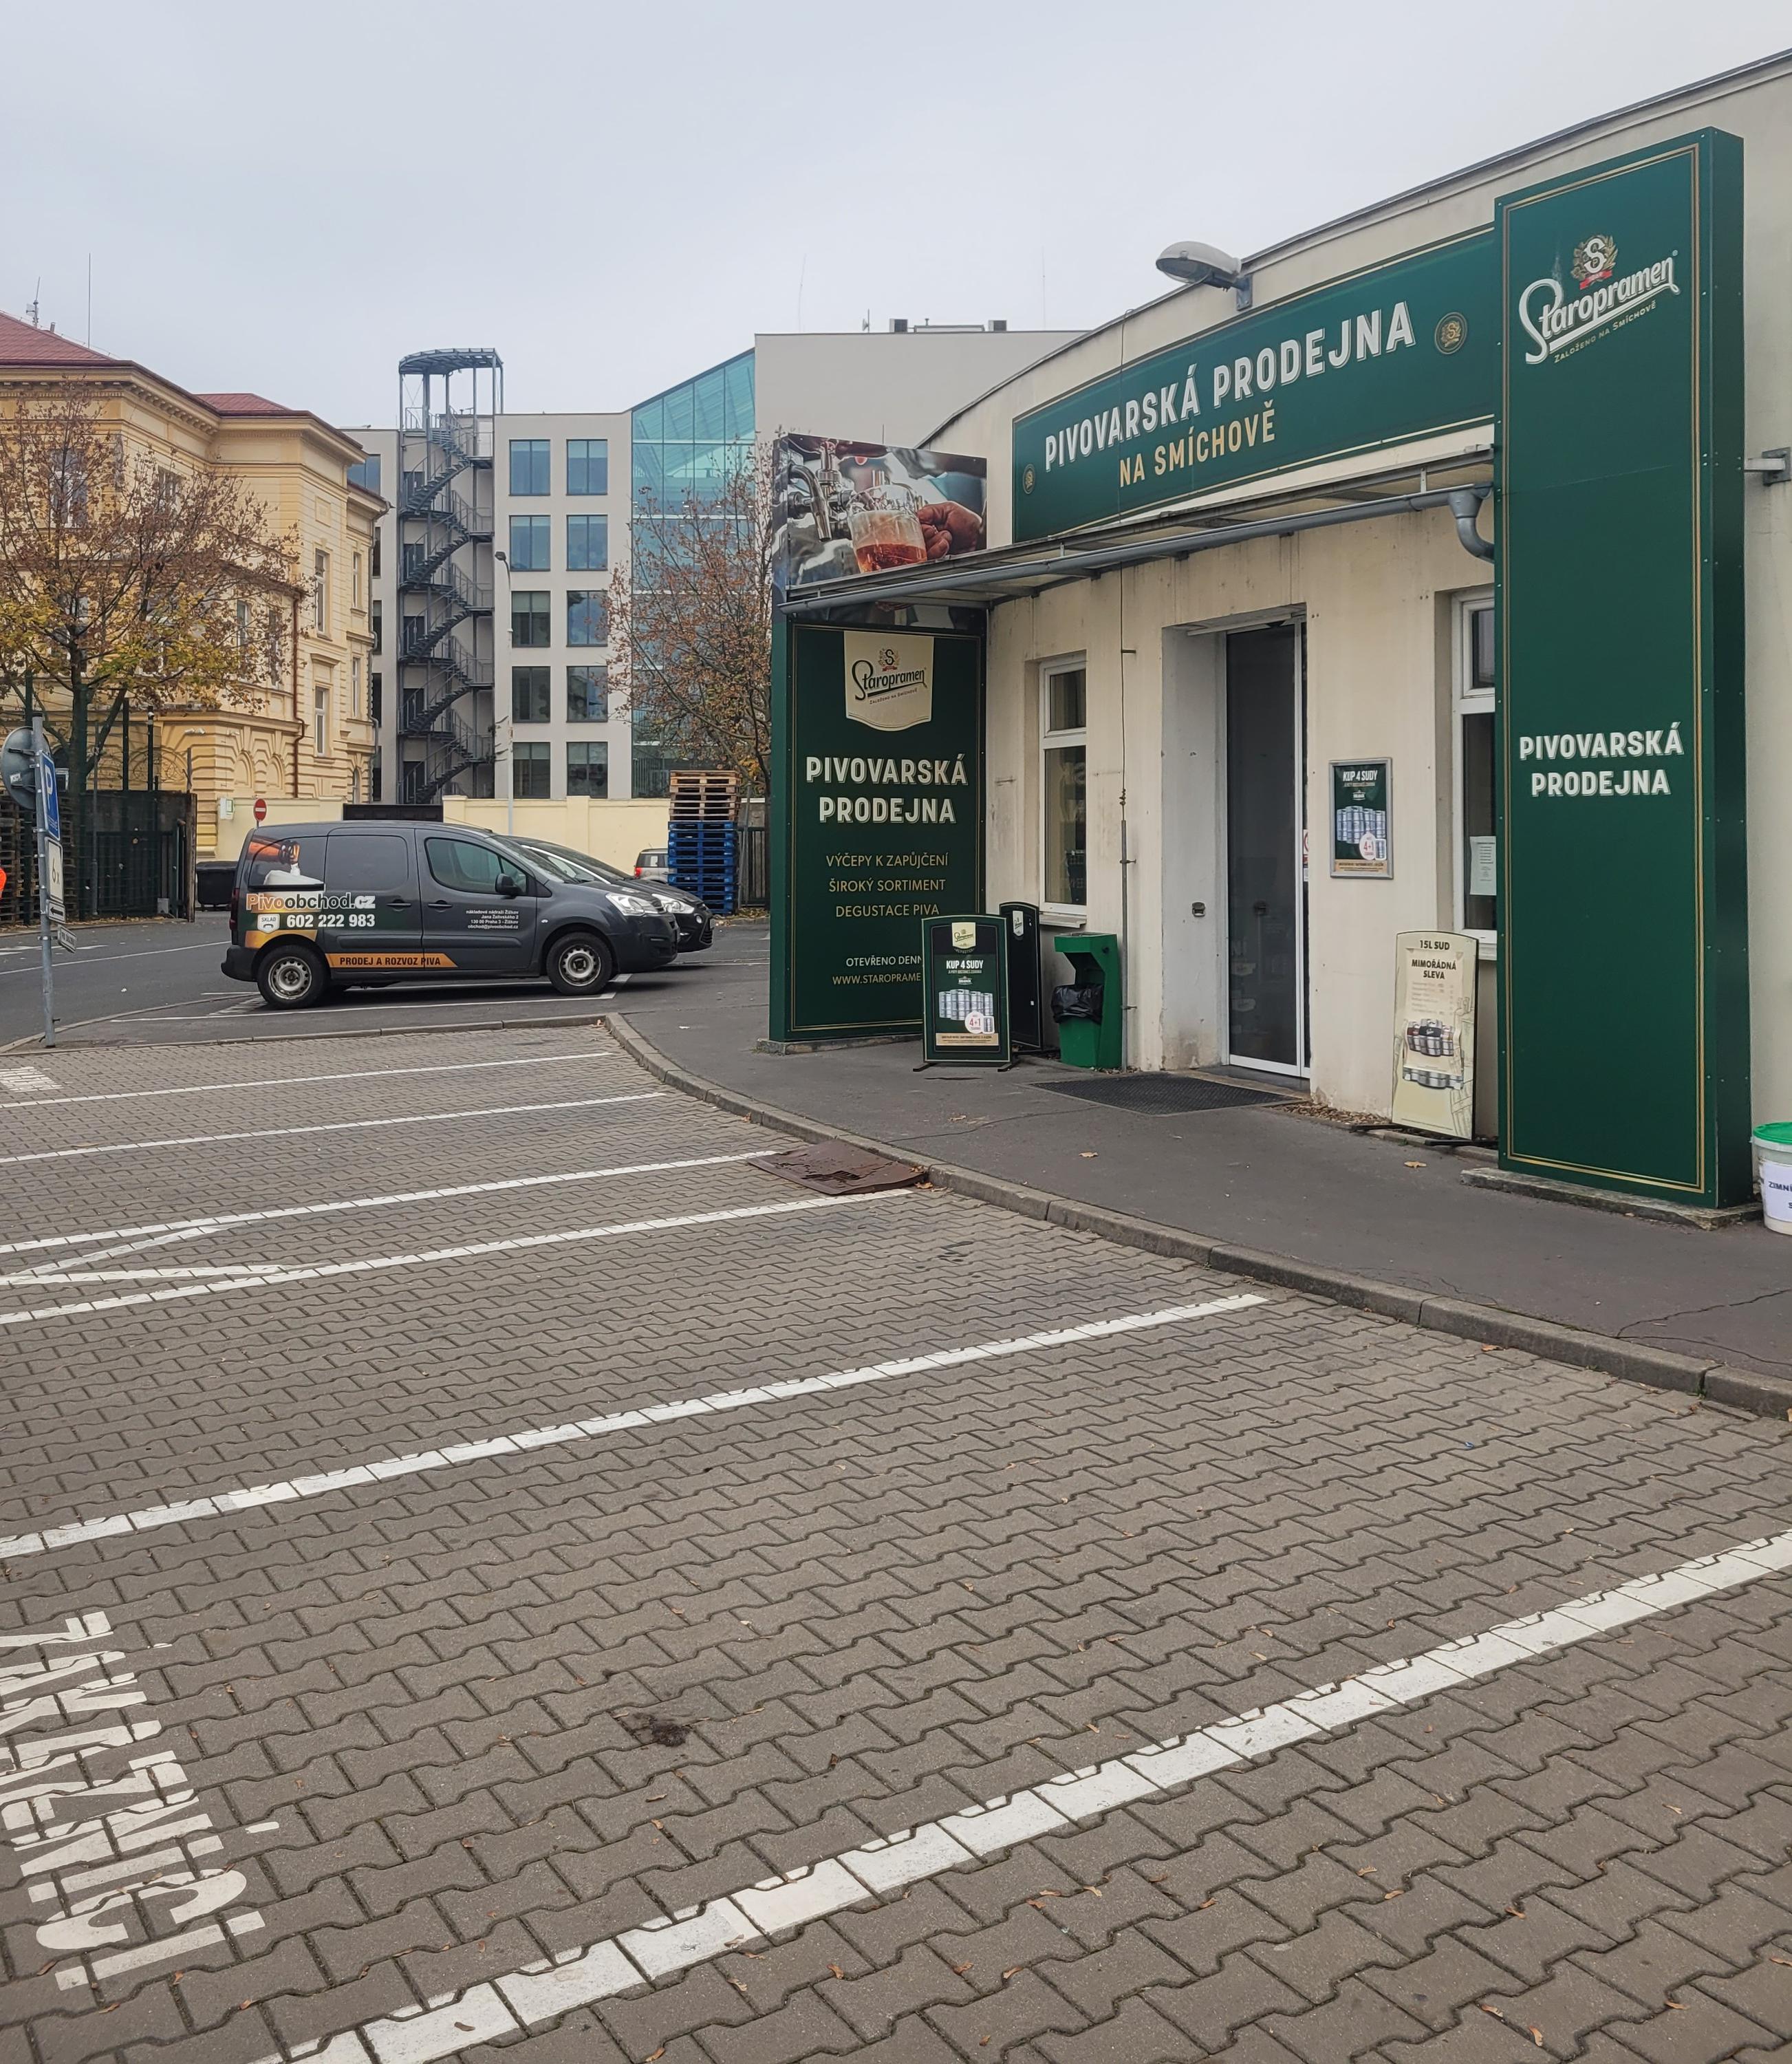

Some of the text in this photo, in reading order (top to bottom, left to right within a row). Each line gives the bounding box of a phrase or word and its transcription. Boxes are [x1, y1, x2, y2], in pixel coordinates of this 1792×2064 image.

[1519, 256, 1681, 365] Staropramen
[1598, 327, 1610, 339] NA
[1045, 301, 1416, 472] PIVOVARSKÁ PRODEJNA
[1119, 400, 1275, 488] NA SMÍCHOVĚ
[852, 659, 927, 701] Staropramen
[1520, 721, 1685, 761] PIVOVARSKÁ
[806, 753, 969, 786] PIVOVARSKÁ
[1343, 769, 1378, 782] KUP 4 SUDY
[45, 764, 53, 811] P
[1532, 768, 1672, 797] PRODEJNA
[819, 796, 956, 824] PRODEJNA
[826, 851, 949, 869] VÝČEPY K ZAPŮJČENÍ
[829, 877, 947, 892] ŠIROKÝ SORTIMENT
[246, 892, 376, 911] Pivoobchod.cz
[836, 903, 940, 918] DEGUSTACE PIVA
[286, 914, 314, 927] 602
[318, 914, 345, 927] 222
[349, 913, 376, 927] 983
[1419, 940, 1450, 950] 15L SUD
[340, 957, 441, 965] PRODEJ A ROZVOZ PIVA
[845, 955, 896, 967] OTEVŘENO
[946, 959, 984, 969] KUP 4 SUDY
[1411, 958, 1456, 971] MIMOŘÁDNÁ
[1423, 970, 1445, 980] SLEVA
